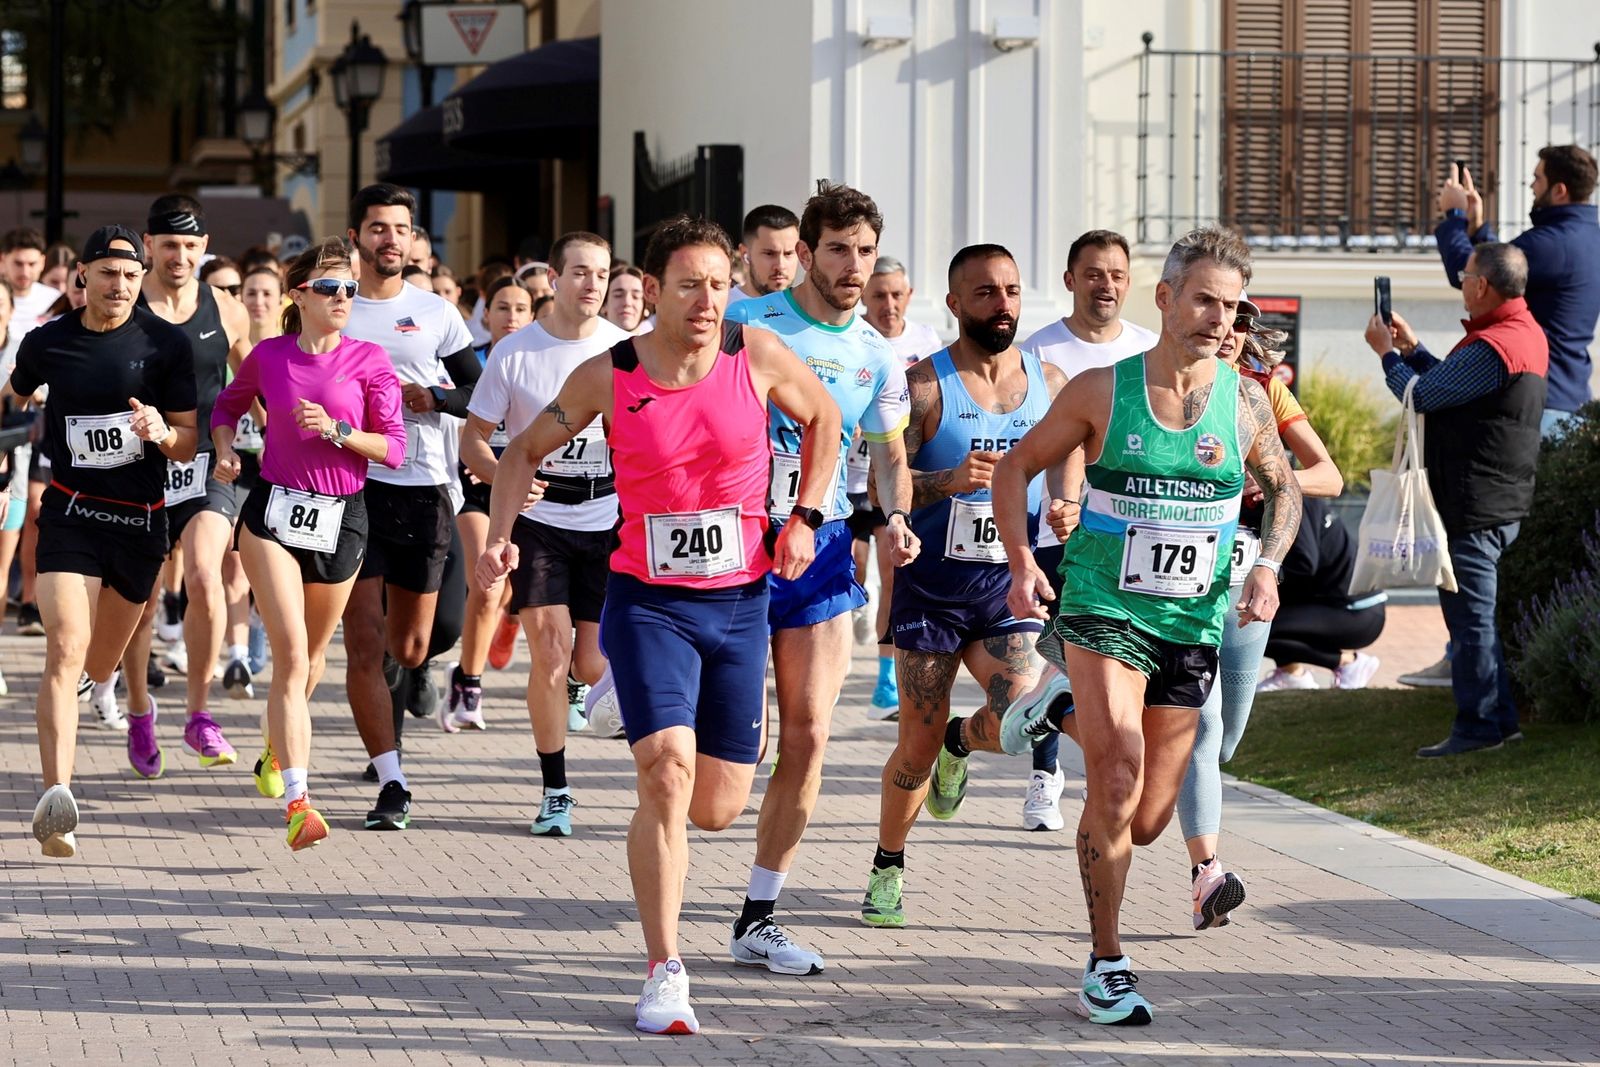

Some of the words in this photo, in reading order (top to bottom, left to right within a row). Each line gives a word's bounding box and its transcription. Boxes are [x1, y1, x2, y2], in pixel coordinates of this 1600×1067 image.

[85, 428, 123, 453] 108
[562, 438, 588, 460] 27
[1125, 476, 1216, 499] ATLETISMO
[75, 504, 145, 526] WONG
[289, 504, 319, 531] 84
[1110, 498, 1225, 521] TORREMOLINOS
[670, 525, 722, 558] 240
[973, 517, 1002, 543] 16
[1151, 543, 1197, 574] 179
